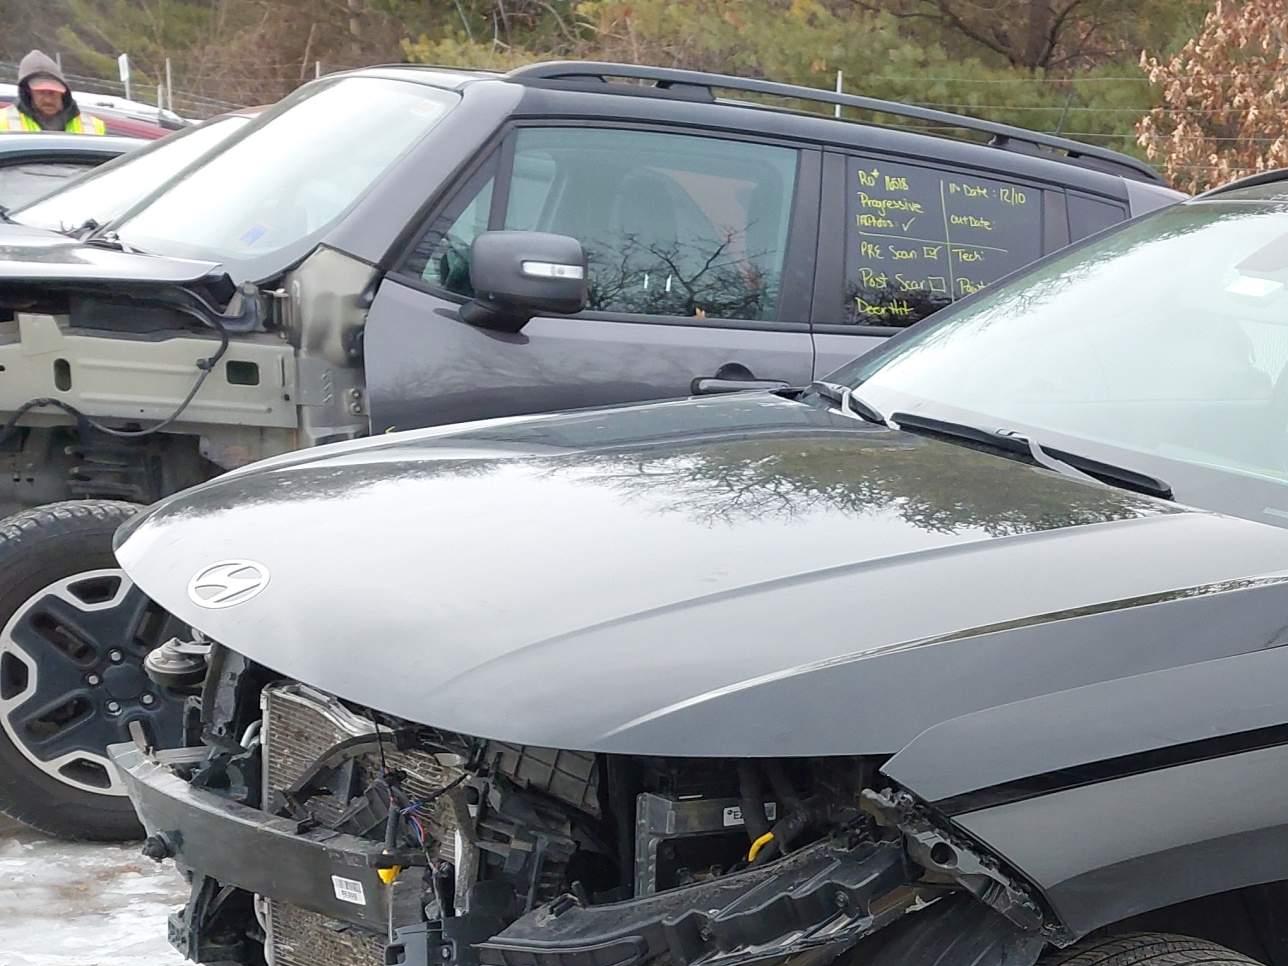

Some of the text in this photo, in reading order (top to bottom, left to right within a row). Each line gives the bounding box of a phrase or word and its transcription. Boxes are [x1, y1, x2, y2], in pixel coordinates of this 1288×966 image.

[856, 192, 924, 217] Progressive
[1000, 187, 1027, 206] 12/10
[888, 245, 917, 260] Scan
[858, 267, 889, 288] Post
